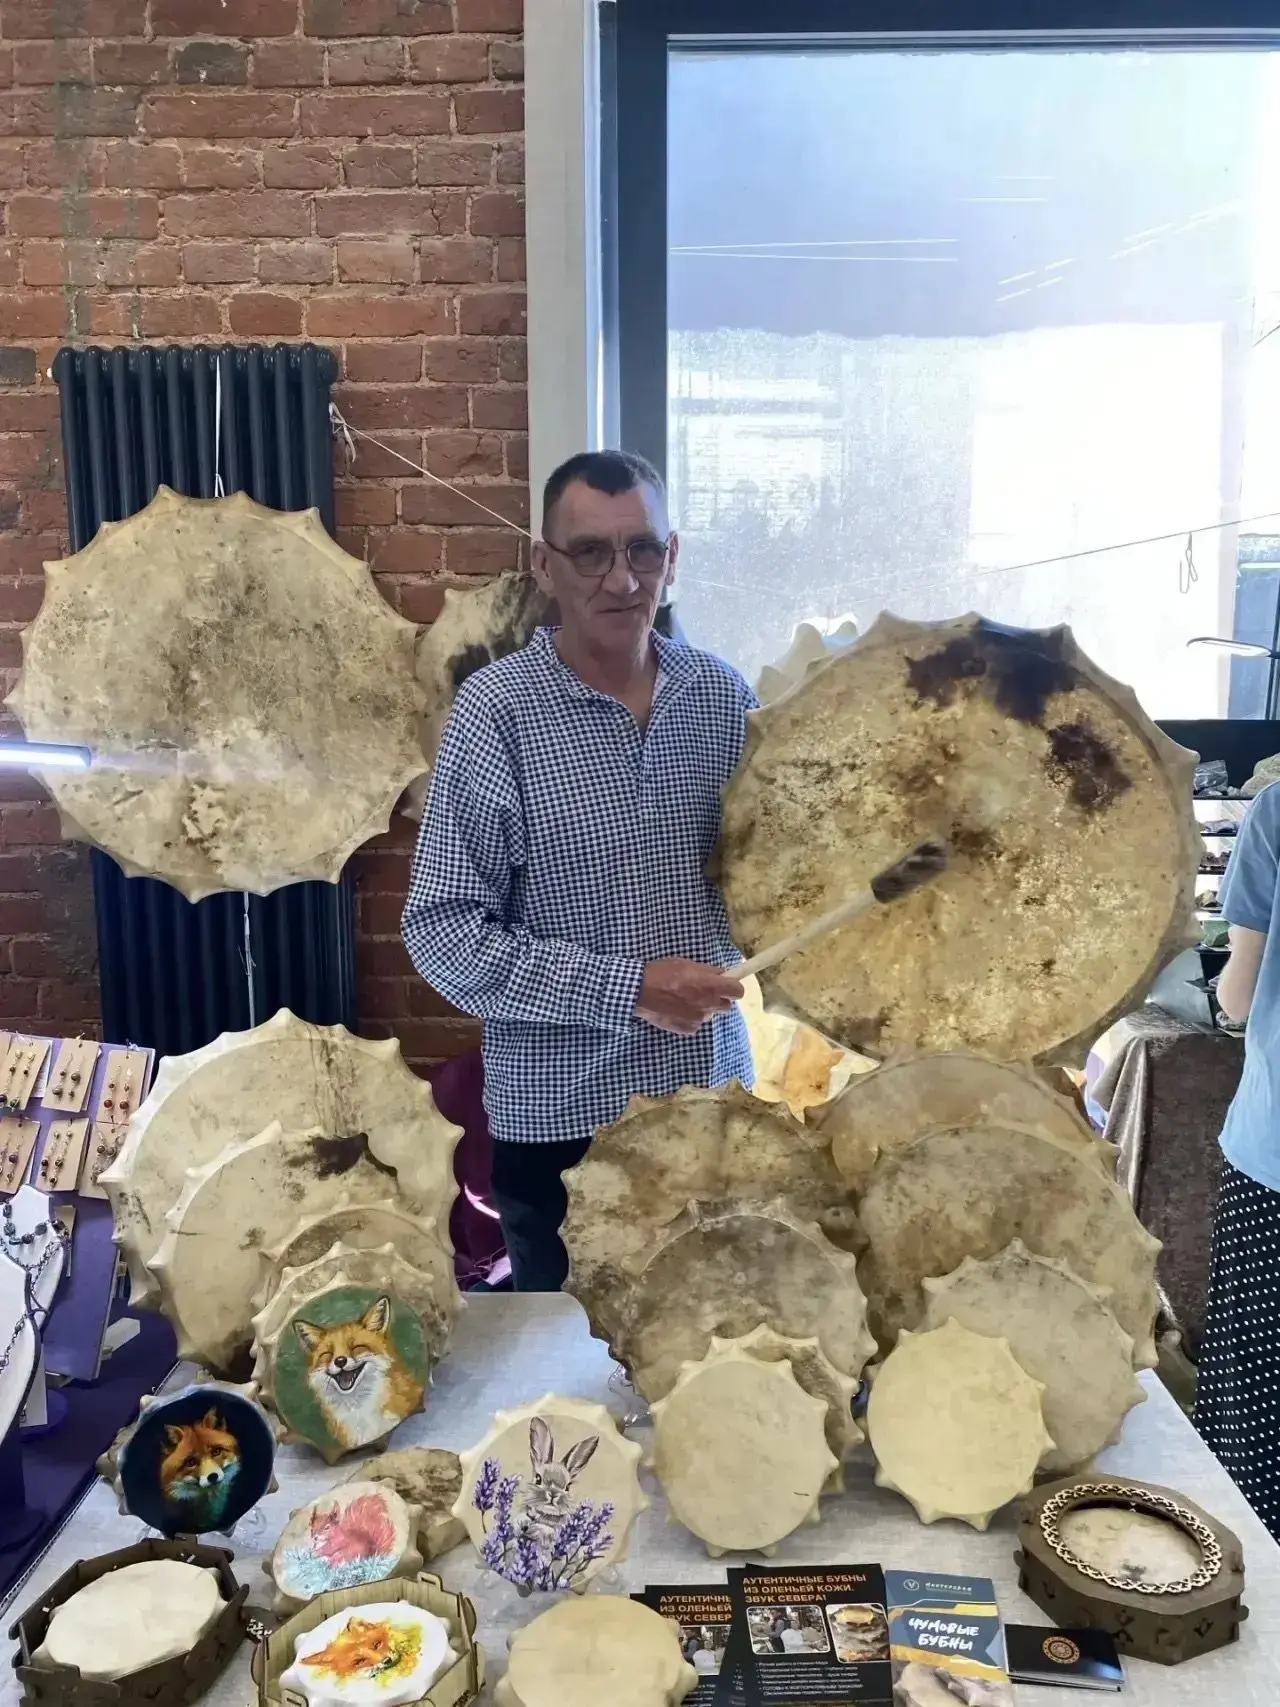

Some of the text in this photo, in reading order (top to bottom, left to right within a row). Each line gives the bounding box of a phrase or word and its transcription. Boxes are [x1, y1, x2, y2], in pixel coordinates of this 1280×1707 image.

[743, 1574, 867, 1584] АУТЕНТИЧНЫЕ БУБНЫ
[761, 1585, 814, 1593] ОЛЕНЬЕЙ
[817, 1584, 855, 1592] КОЖИ.
[745, 1594, 827, 1603] ЗВУК СЕВЕРА!
[678, 1604, 732, 1612] ОЛЕНЬЕЙ
[909, 1618, 980, 1637] ЧУМОВЫЕ
[918, 1634, 973, 1651] БУБНЫ
